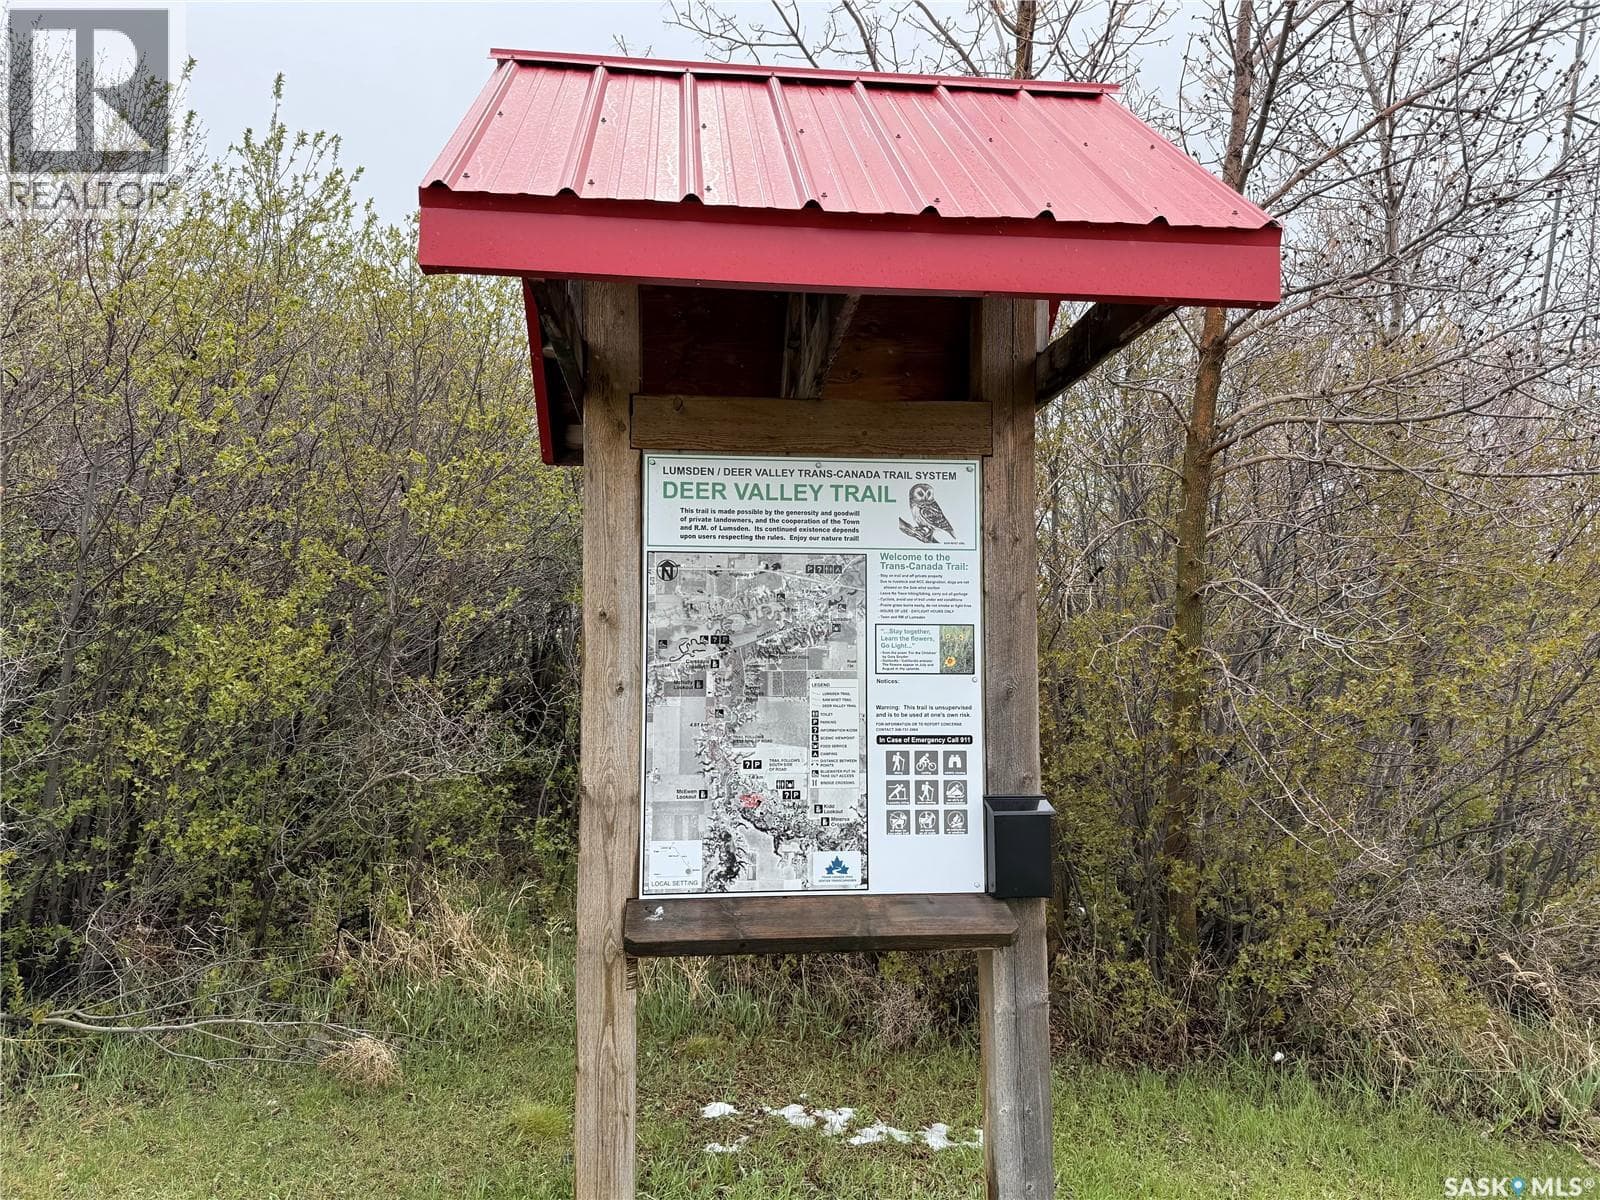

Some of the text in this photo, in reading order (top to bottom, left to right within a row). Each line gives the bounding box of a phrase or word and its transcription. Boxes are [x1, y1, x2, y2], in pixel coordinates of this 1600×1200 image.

[662, 466, 715, 476] LUMSDEN
[723, 467, 752, 477] DEER
[752, 468, 795, 478] VALLEY
[798, 469, 880, 479] TRANS-CANADA
[883, 470, 912, 480] TRAIL
[915, 471, 957, 481] SYSTEM
[662, 480, 897, 503] DEER VALLEY TRAIL
[737, 508, 763, 516] possible
[786, 509, 819, 517] generosity
[834, 510, 860, 518] goodwill
[880, 552, 950, 561] Welcome to the
[880, 562, 968, 571] Trans-Canada Trail:
